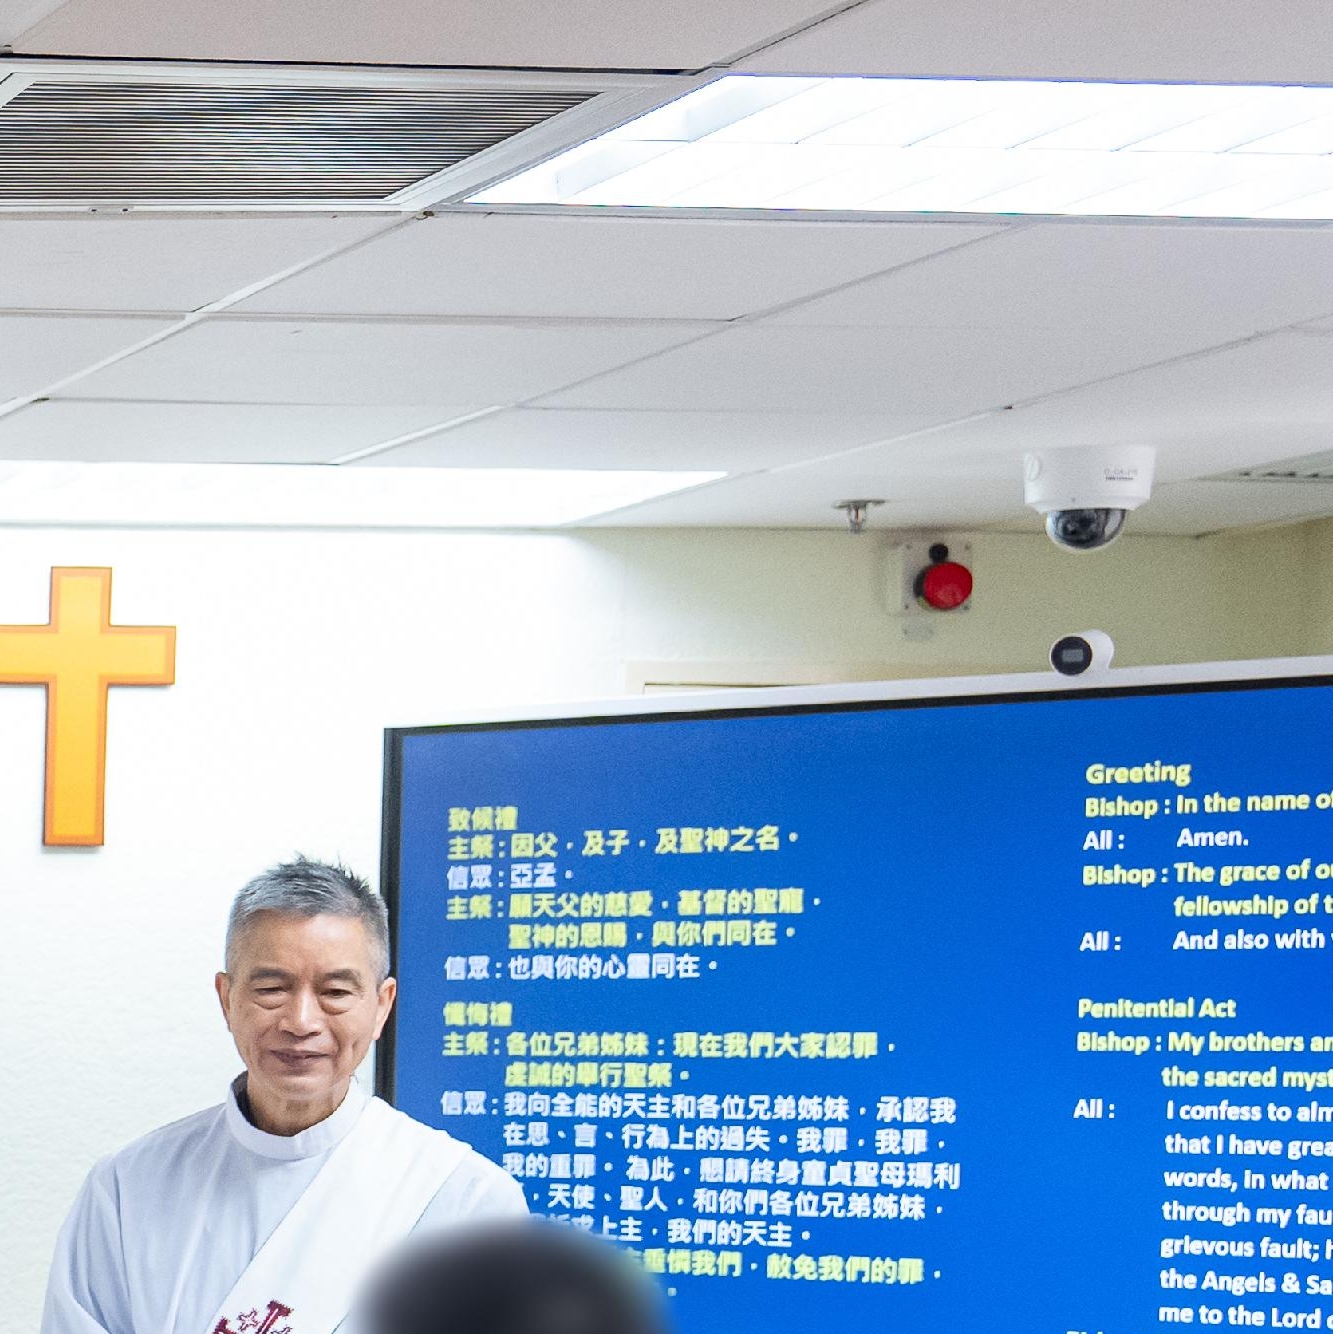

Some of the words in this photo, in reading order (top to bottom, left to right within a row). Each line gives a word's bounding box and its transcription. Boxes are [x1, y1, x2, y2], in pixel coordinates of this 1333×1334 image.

[1086, 761, 1190, 786] Greeting
[1086, 796, 1158, 819] Bishop
[1177, 795, 1197, 813] In
[1204, 792, 1240, 812] the
[1247, 795, 1310, 811] name
[1083, 830, 1112, 850] All
[1177, 828, 1248, 846] Amen.
[1083, 864, 1156, 887] Bishop
[1174, 862, 1214, 882] The
[1220, 866, 1280, 886] grace
[1286, 859, 1310, 879] of
[1174, 895, 1288, 918] fellowship
[1294, 893, 1319, 913] of
[1080, 931, 1109, 951] All
[1173, 929, 1218, 949] And
[1224, 929, 1268, 949] also
[1275, 928, 1325, 948] with
[1079, 997, 1194, 1018] Penitential
[1199, 999, 1236, 1017] Act
[1077, 1031, 1150, 1055] Bishop
[1169, 1032, 1205, 1055] My
[1209, 1032, 1304, 1051] brothers
[1162, 1066, 1199, 1086] the
[1205, 1067, 1276, 1087] sacred
[1074, 1099, 1102, 1118] All
[1167, 1101, 1173, 1119] I
[1180, 1100, 1261, 1120] confess
[1268, 1103, 1292, 1121] to
[1165, 1134, 1210, 1154] that
[1217, 1135, 1223, 1154] I
[1229, 1134, 1282, 1155] have
[1164, 1168, 1237, 1192] words,
[1244, 1170, 1264, 1189] in
[1271, 1170, 1329, 1190] what
[1162, 1201, 1250, 1226] through
[1256, 1208, 1291, 1228] my
[1161, 1236, 1254, 1258] grievous
[1260, 1237, 1319, 1261] fault;
[1160, 1268, 1197, 1289] the
[1201, 1271, 1276, 1295] Angels
[1281, 1273, 1300, 1293] &
[1159, 1307, 1193, 1323] me
[1199, 1306, 1222, 1324] to
[1228, 1305, 1265, 1326] the
[1272, 1308, 1321, 1328] Lord
